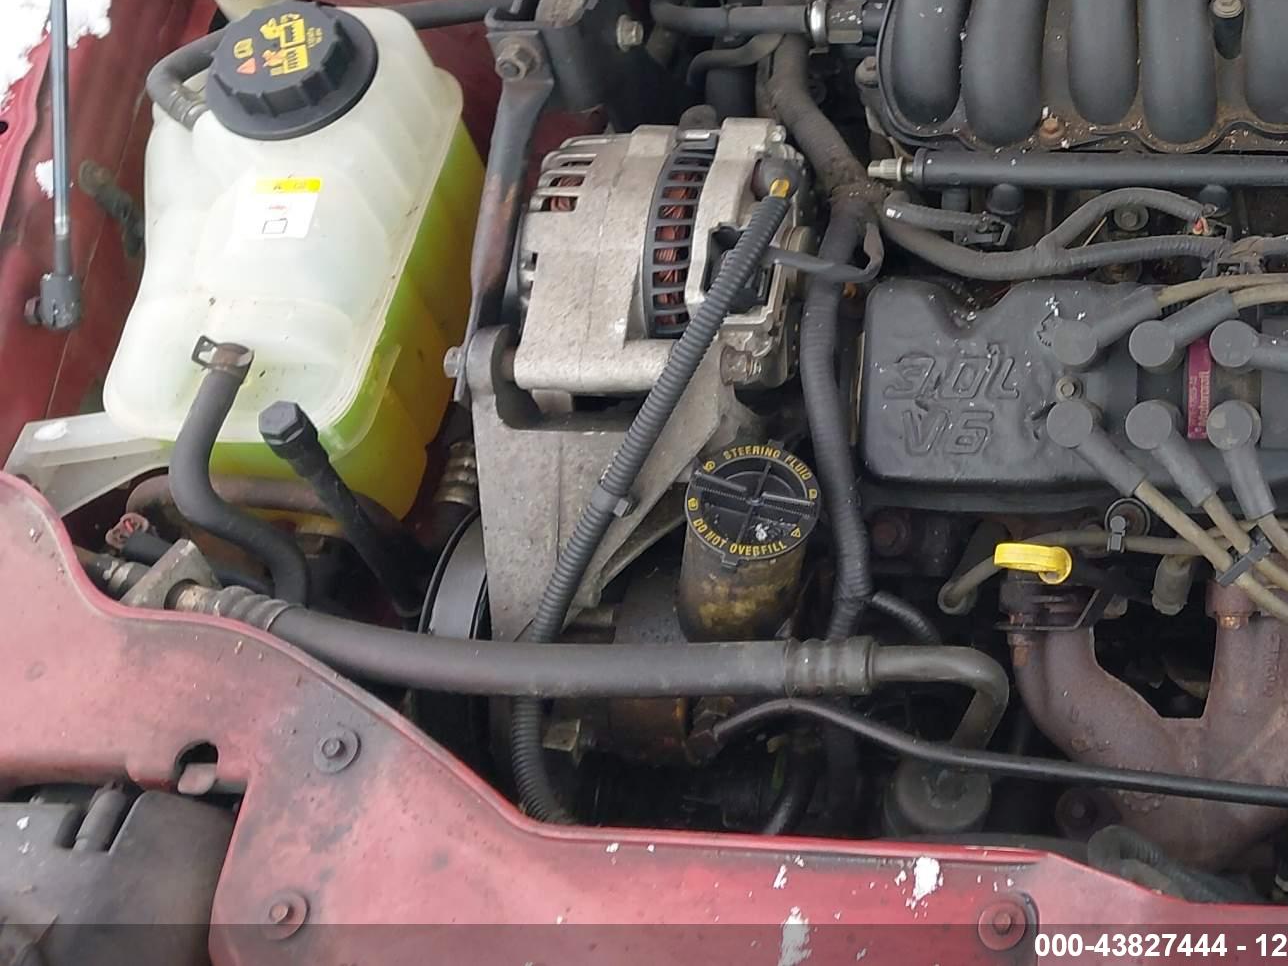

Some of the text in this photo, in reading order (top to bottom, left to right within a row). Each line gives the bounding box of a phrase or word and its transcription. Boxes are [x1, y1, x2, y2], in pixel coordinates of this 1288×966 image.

[902, 409, 995, 457] V6
[723, 446, 813, 480] STEERING FLUID
[693, 518, 788, 557] DO NOT OVERFILL
